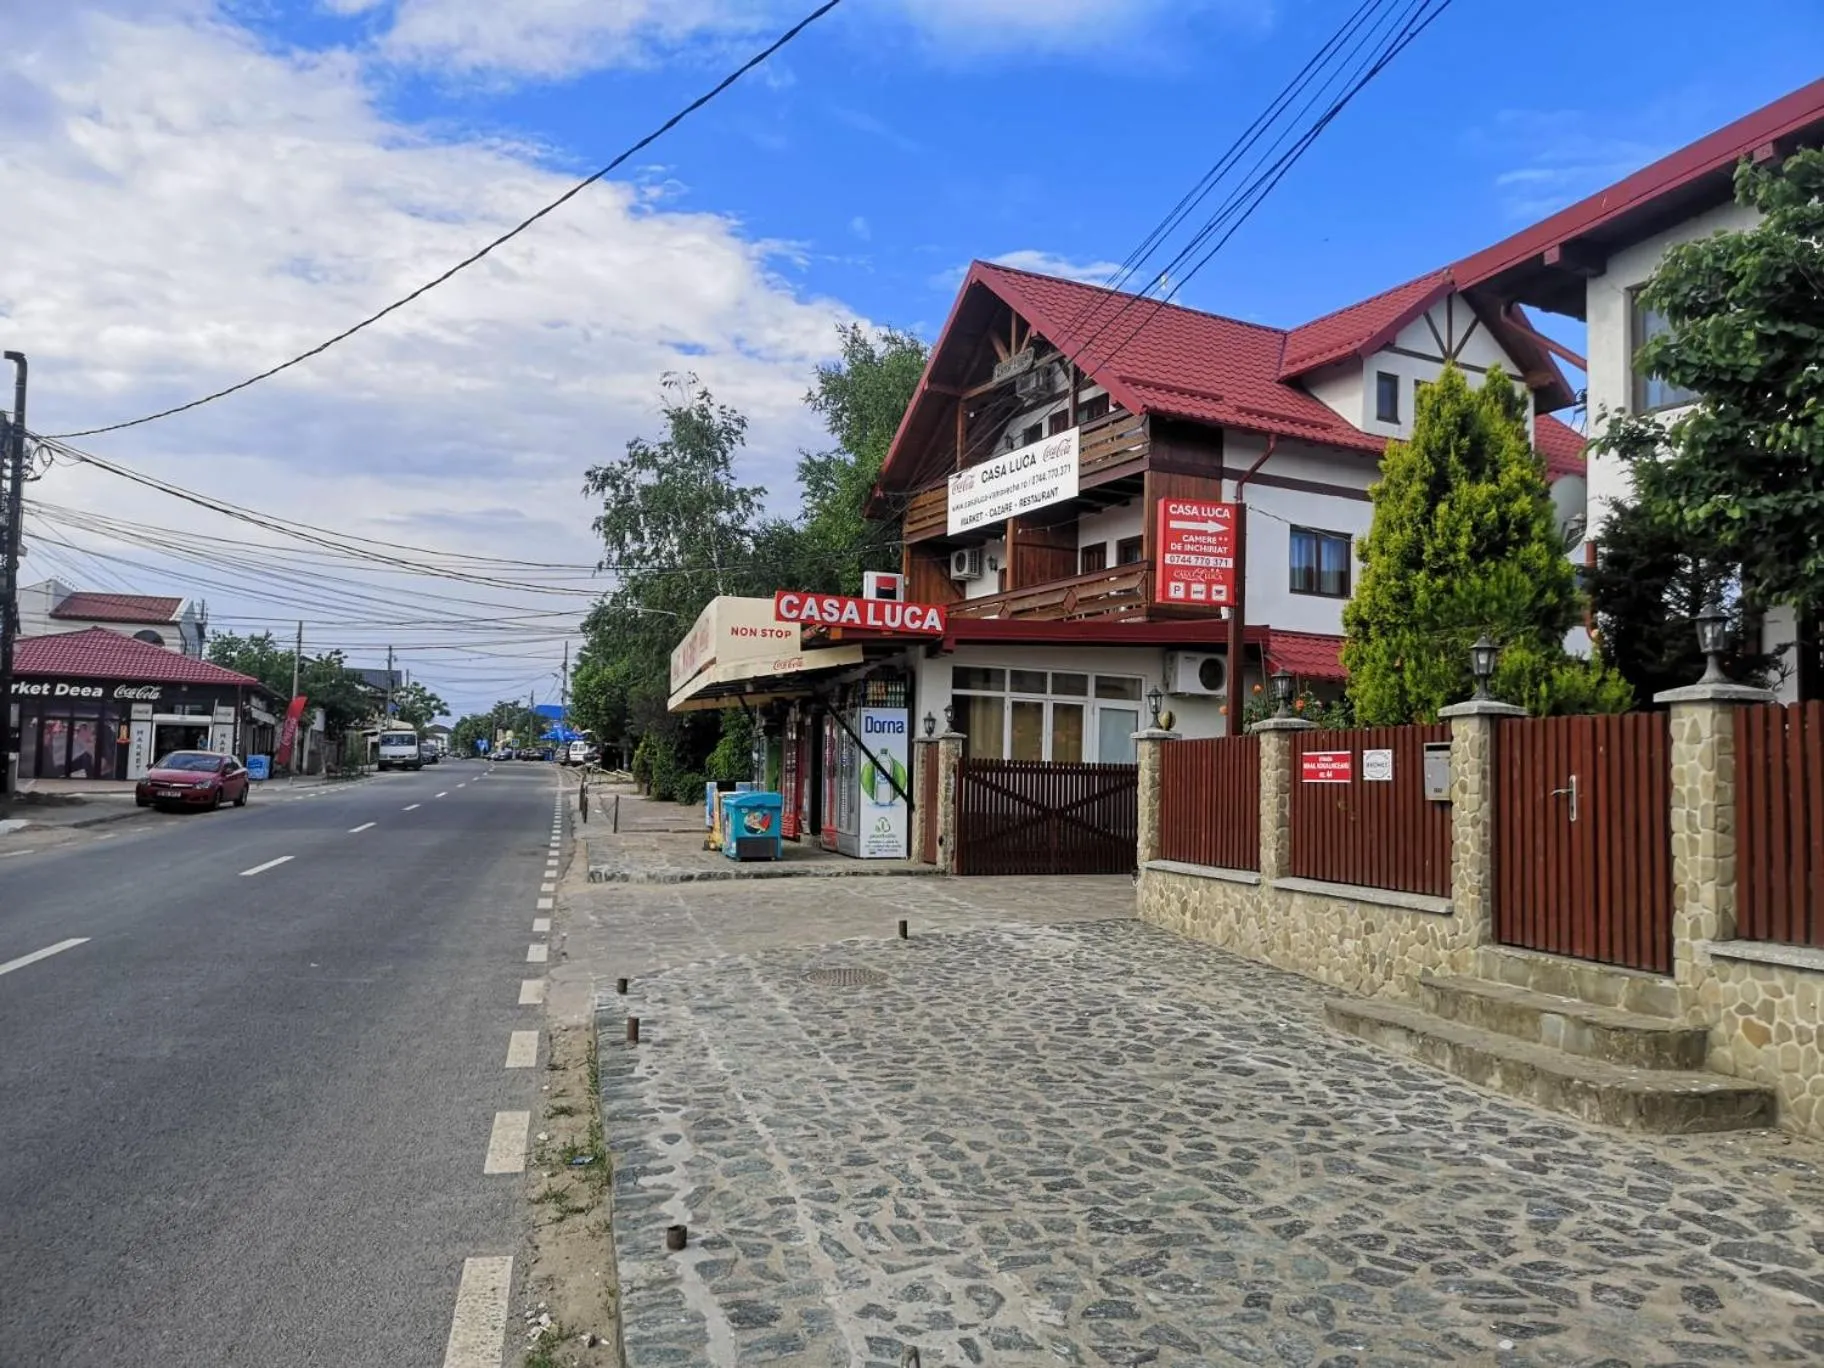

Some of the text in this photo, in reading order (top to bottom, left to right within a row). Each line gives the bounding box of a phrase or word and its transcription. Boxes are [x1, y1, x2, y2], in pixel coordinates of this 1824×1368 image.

[980, 452, 1037, 484] CASA LUCA
[989, 501, 1012, 518] CAZARE
[1018, 486, 1059, 508] RESTAURANT
[1169, 504, 1231, 519] CASA LUCA
[1182, 534, 1217, 544] CAMERE
[1170, 542, 1228, 554] DE INCHIRIAT
[1169, 555, 1228, 567] 0744 770 371
[779, 594, 943, 631] CASA LUCA
[731, 626, 792, 639] NON STOP
[10, 681, 104, 697] rket Deea
[865, 715, 905, 734] Dorna
